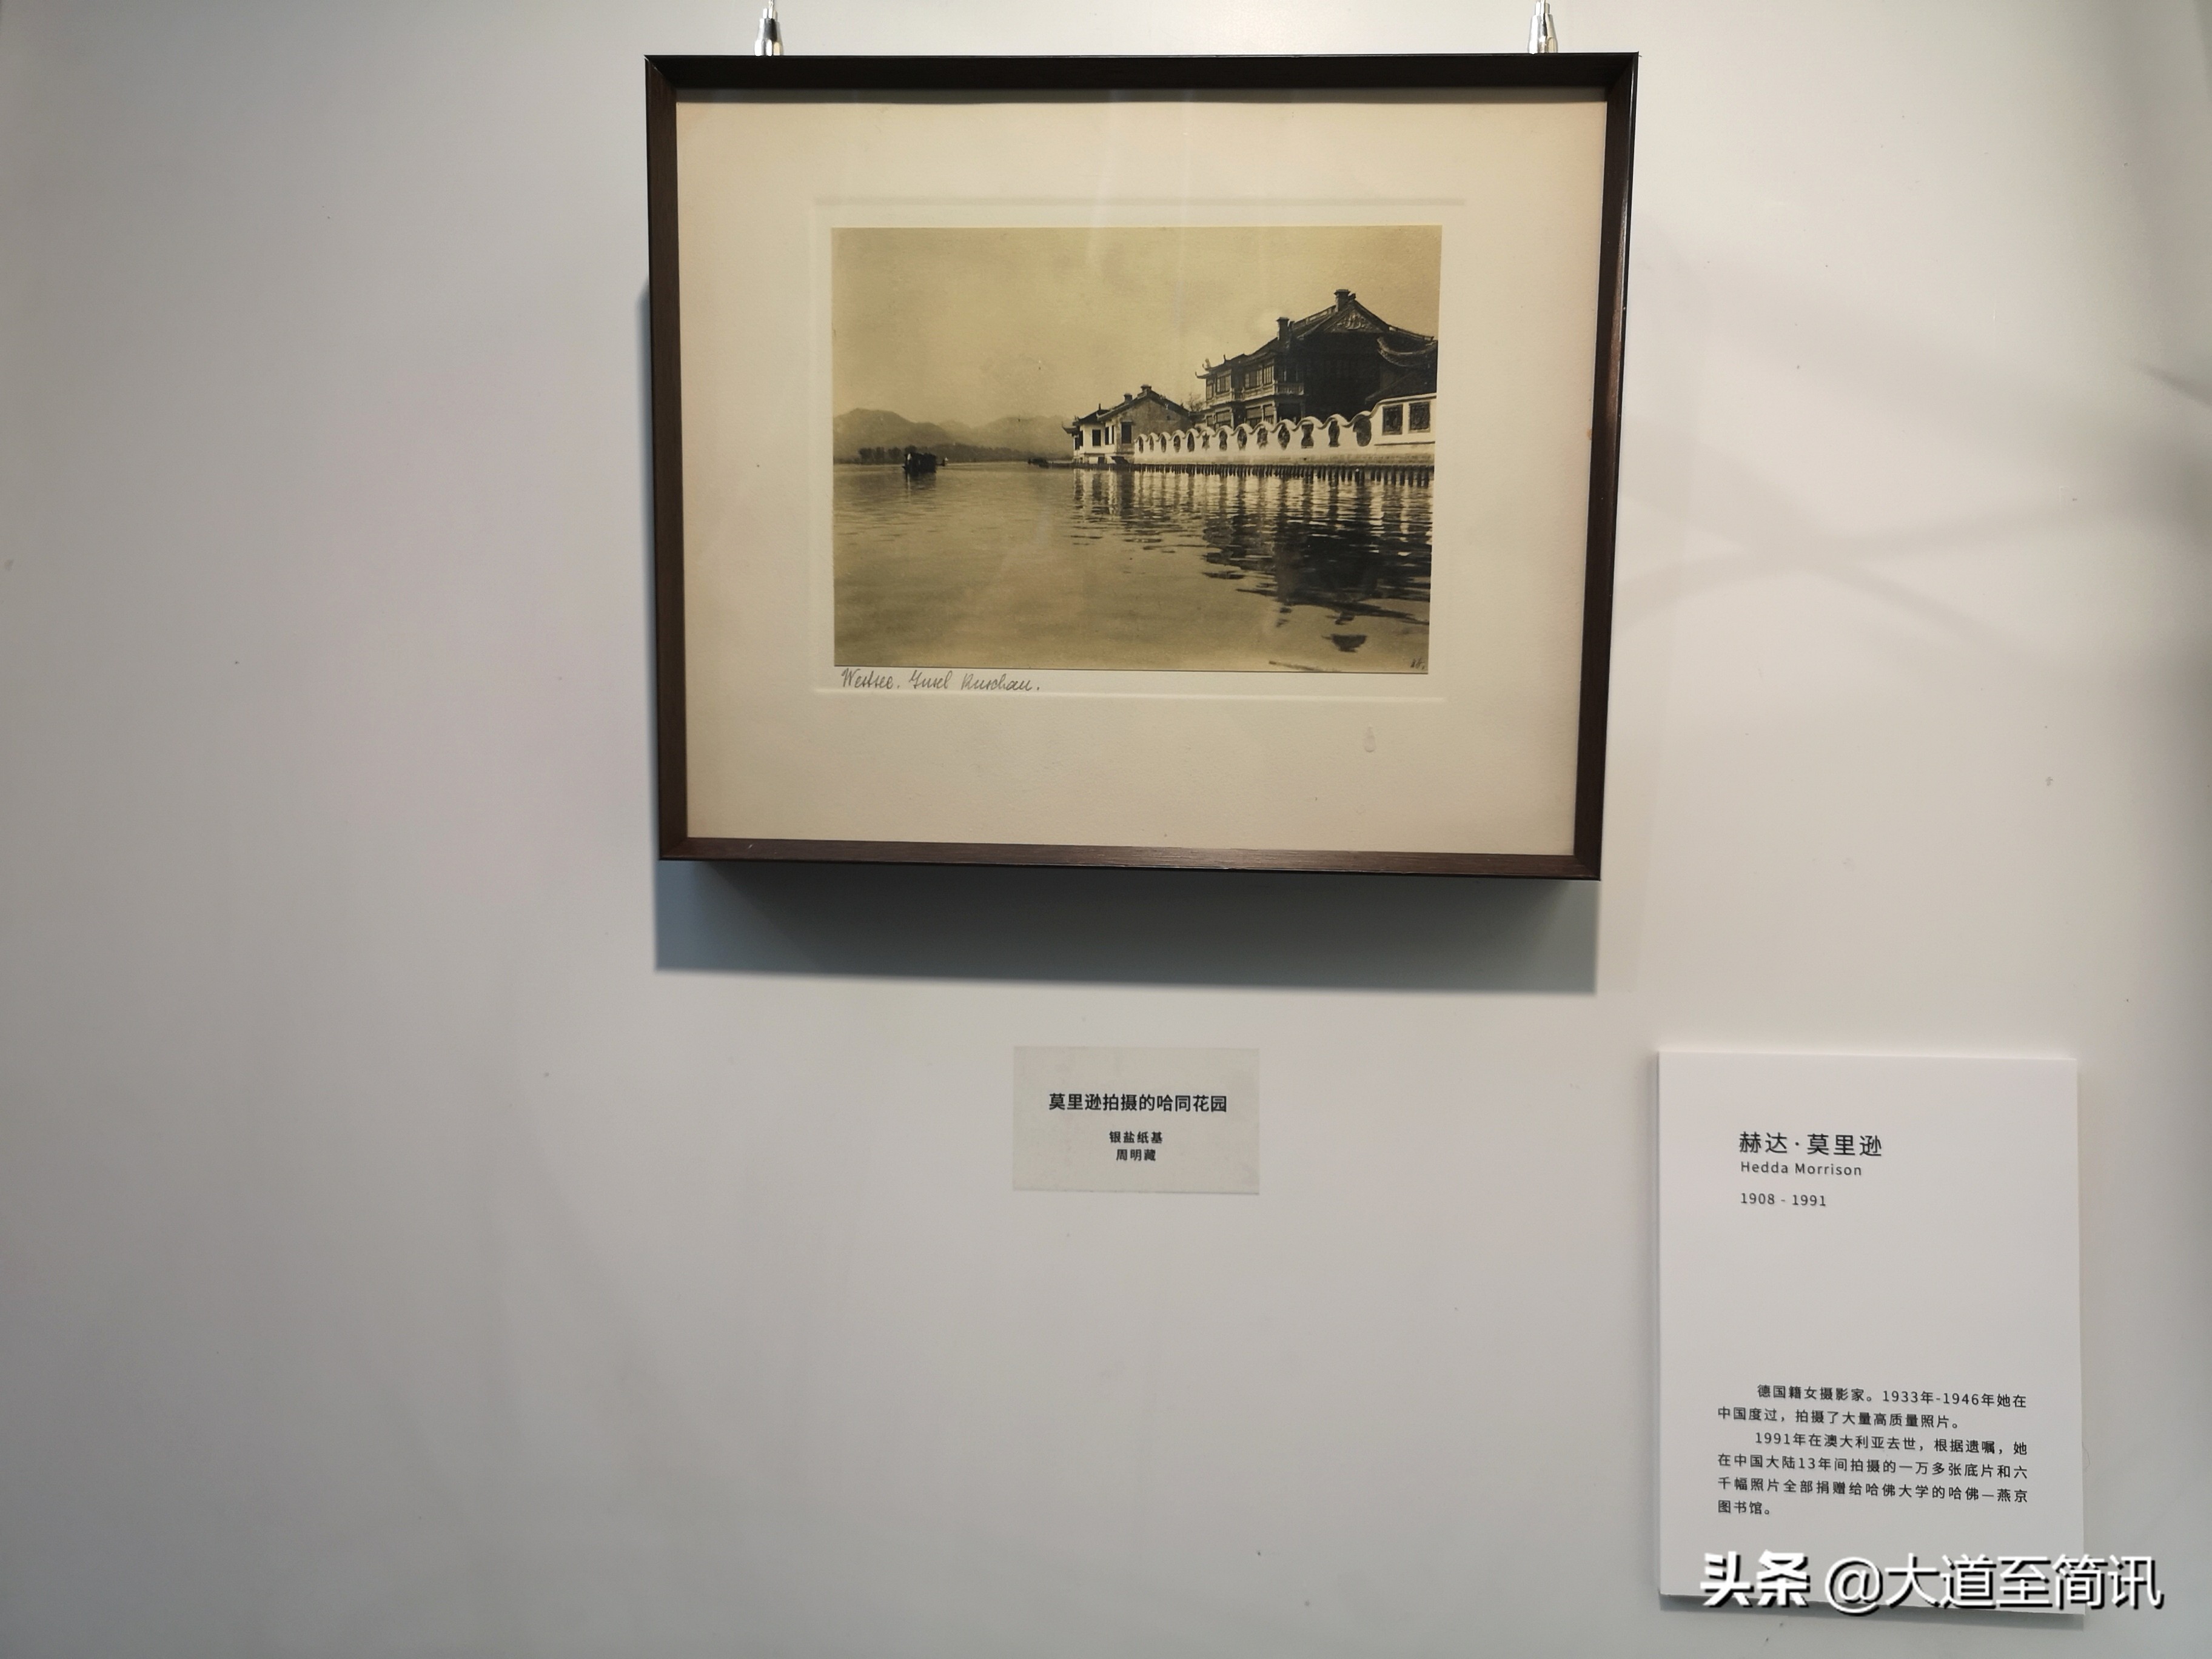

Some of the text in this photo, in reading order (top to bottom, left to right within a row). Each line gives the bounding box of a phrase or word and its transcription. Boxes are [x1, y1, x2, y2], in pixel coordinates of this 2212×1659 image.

[1048, 1093, 1227, 1113] 莫里逊拍摄的哈同花园
[1108, 1131, 1163, 1144] 银盐纸基
[1738, 1131, 1882, 1157] 赫达·莫里逊
[1116, 1149, 1156, 1162] 周明藏
[1740, 1161, 1862, 1176] Hedda Morrison
[1740, 1192, 1775, 1205] 1908
[1792, 1194, 1826, 1207] 1991
[1717, 1406, 1959, 1429] 中国度过，拍摄了大量高质量照片。
[1755, 1432, 2028, 1456] 1991年在澳大利亚去世，根据遗嘱，她
[1717, 1453, 2028, 1480] 在中国大陆13年间拍摄的一万多张底片和六
[1717, 1500, 1771, 1515] 图书馆。
